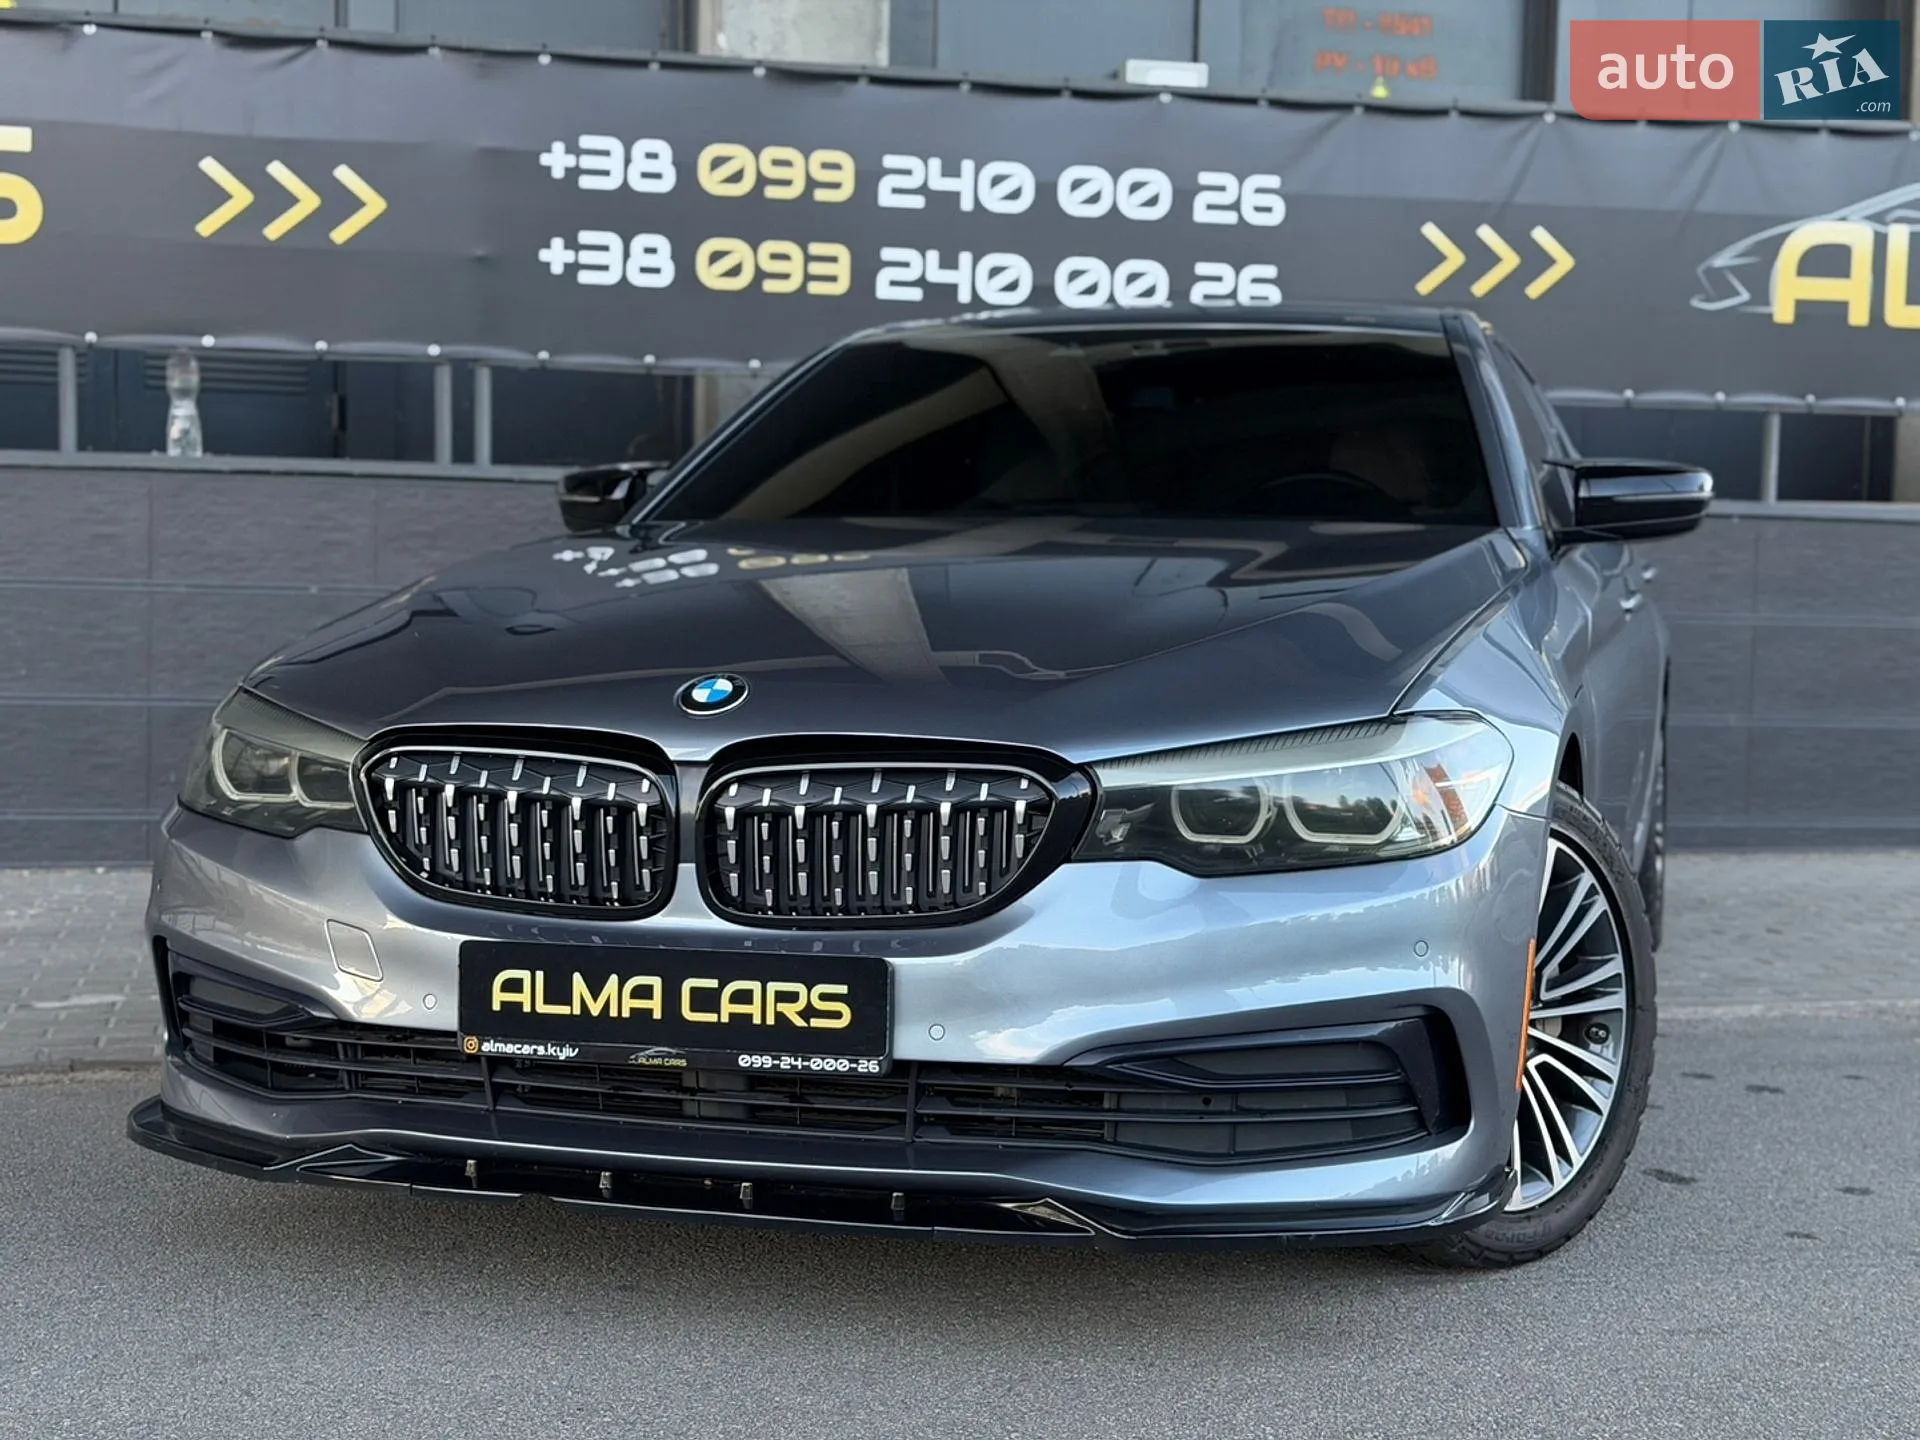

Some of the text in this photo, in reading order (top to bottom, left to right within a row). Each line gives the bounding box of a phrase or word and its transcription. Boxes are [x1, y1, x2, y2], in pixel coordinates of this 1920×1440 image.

[538, 133, 1287, 227] +38 099 240 00 26
[538, 229, 1283, 310] +38 093 240 00 26
[491, 968, 853, 1030] ALMA CARS
[481, 1039, 580, 1060] almacars.kyiv
[738, 1054, 880, 1073] 099-24-000-26
